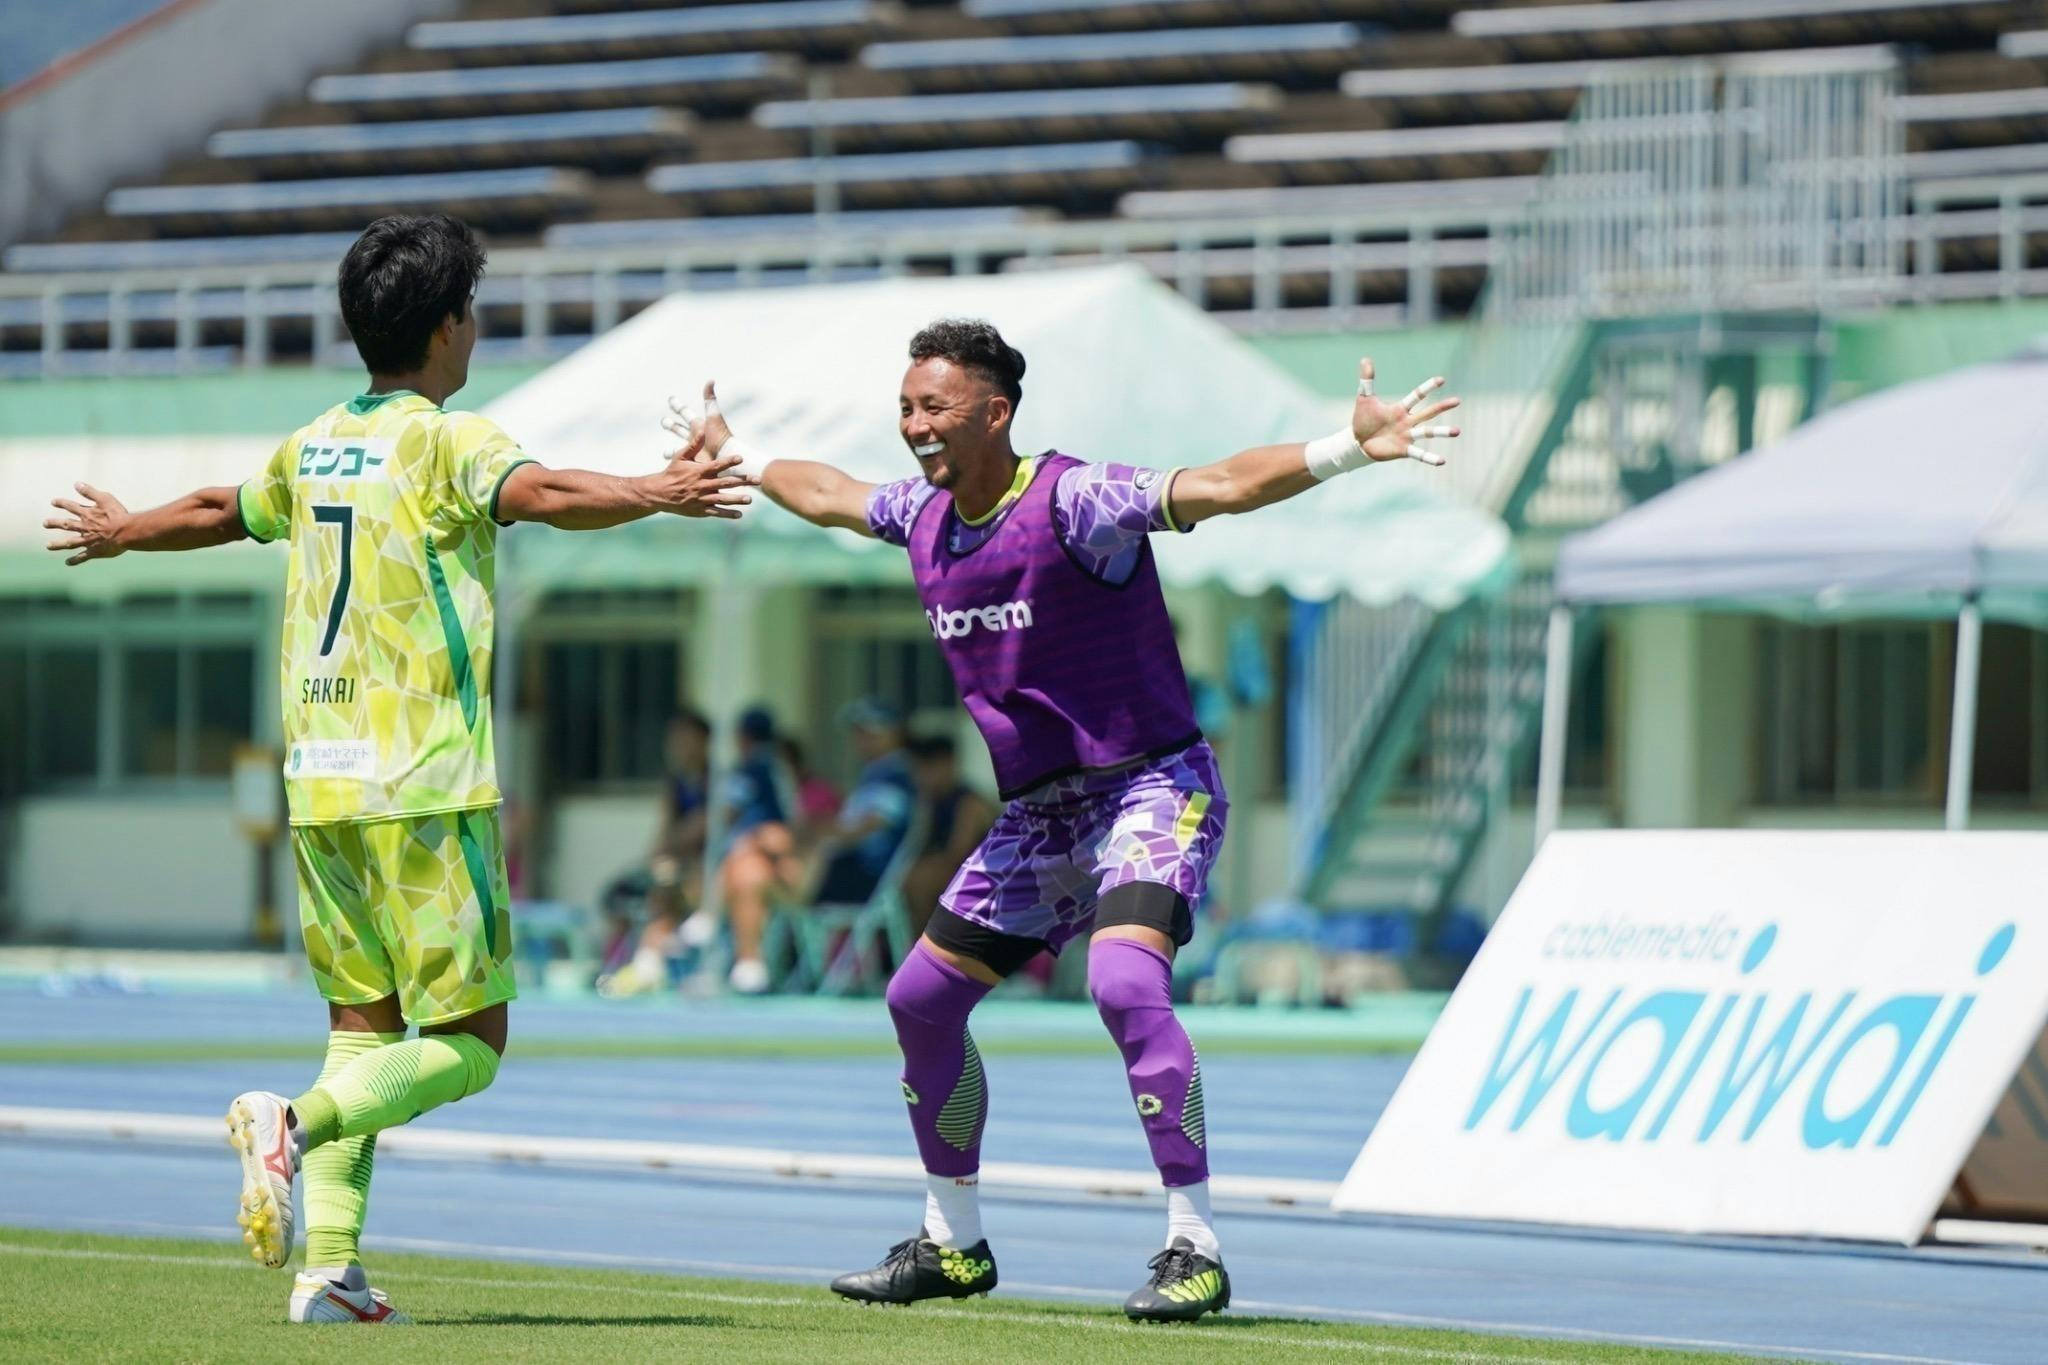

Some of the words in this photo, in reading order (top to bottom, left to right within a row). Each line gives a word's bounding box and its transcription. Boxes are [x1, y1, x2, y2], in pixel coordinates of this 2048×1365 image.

[299, 443, 384, 476] センコー
[311, 505, 353, 656] 7
[302, 677, 355, 704] SAKAI
[1464, 924, 2016, 1149] waiwai
